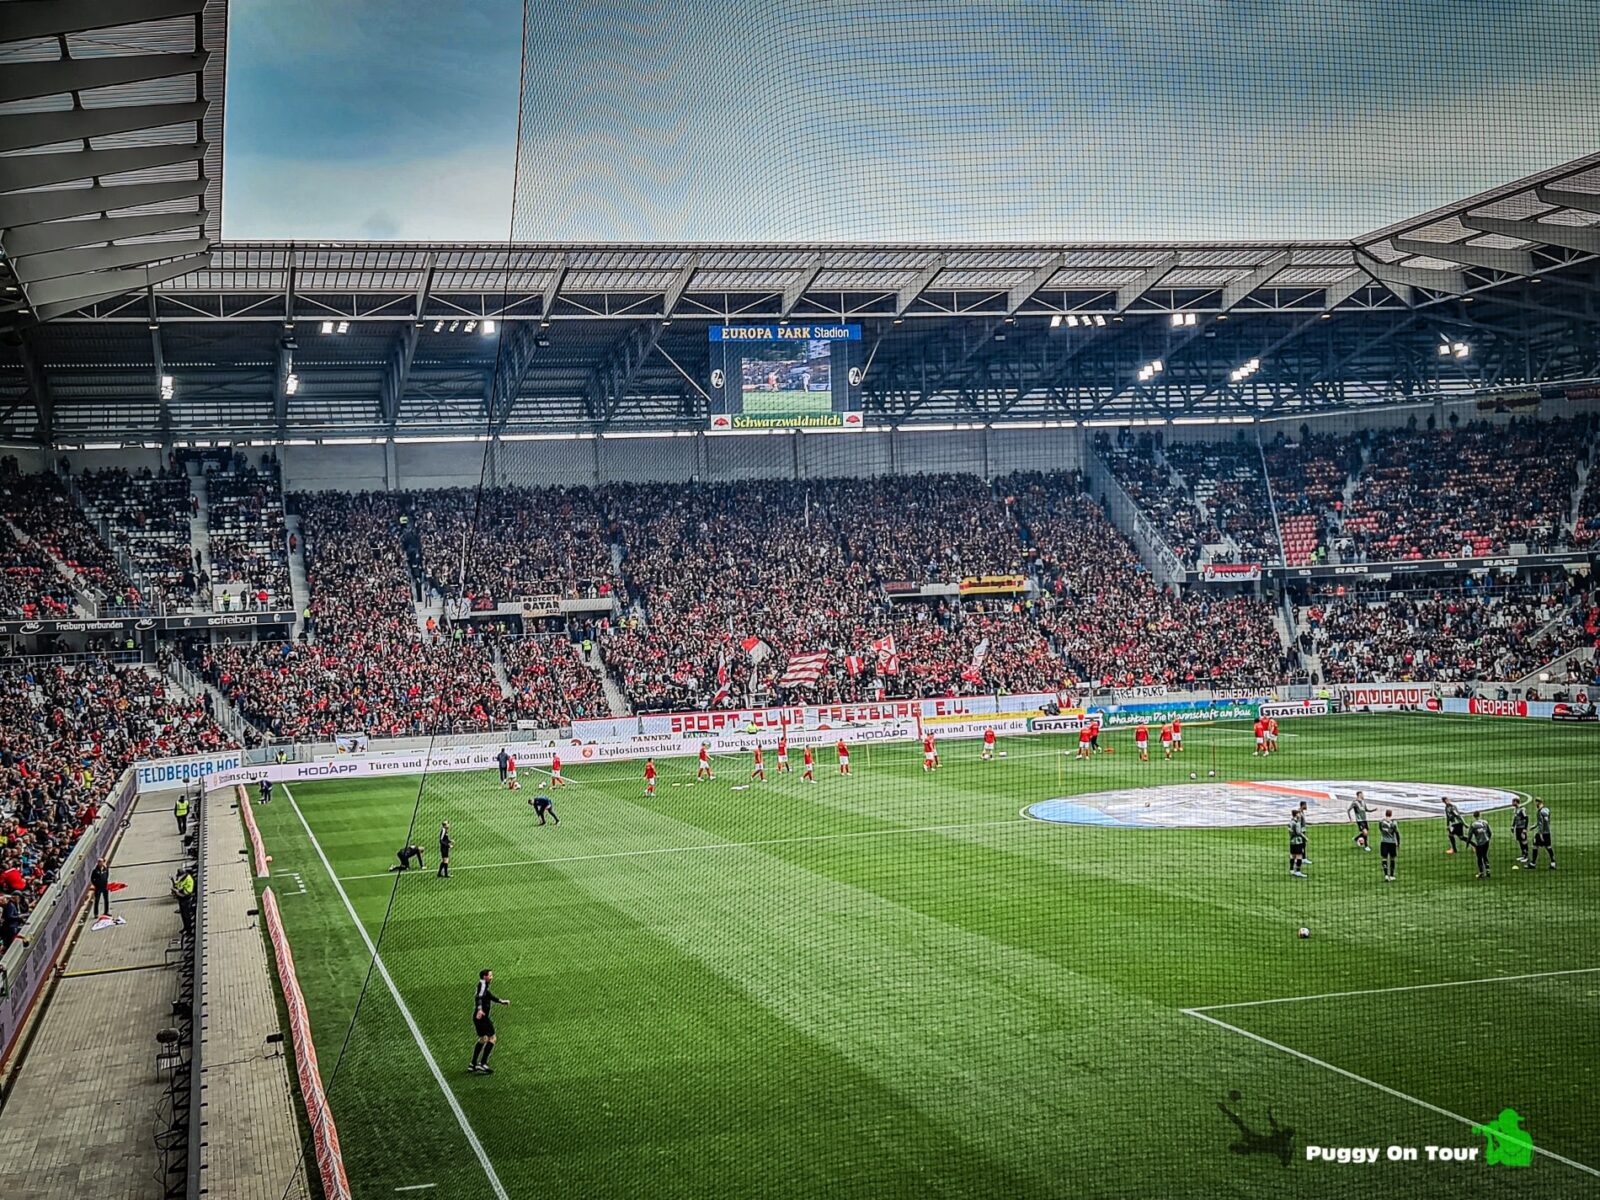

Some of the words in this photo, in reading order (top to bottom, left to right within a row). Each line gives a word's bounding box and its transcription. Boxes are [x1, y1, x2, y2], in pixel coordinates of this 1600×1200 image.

[722, 327, 773, 339] EUROPA
[778, 326, 811, 339] PARK
[814, 327, 849, 338] Stadion
[733, 415, 842, 428] Schwarzwaldmilch
[1483, 559, 1519, 567] RAFI
[1334, 566, 1369, 574] RAFI
[523, 601, 560, 611] QATAR
[25, 622, 40, 630] VAG
[56, 622, 86, 632] Freiburg
[86, 620, 124, 630] verbunden
[1212, 686, 1276, 700] MEINERZHAGEN
[1260, 705, 1326, 718] GRAFRIED
[1474, 699, 1521, 716] NEOPERL
[1153, 712, 1167, 722] Die
[1168, 708, 1220, 722] Mannschaft
[1233, 707, 1251, 718] Bau
[947, 724, 965, 734] und
[993, 721, 1007, 730] auf
[1010, 720, 1023, 729] die
[631, 733, 672, 743] TANNEN
[599, 743, 682, 757] Explosionsschutz
[368, 761, 400, 771] Türen
[402, 758, 422, 769] und
[454, 755, 472, 765] auf
[473, 754, 489, 764] die
[139, 761, 213, 784] FELDBERGER
